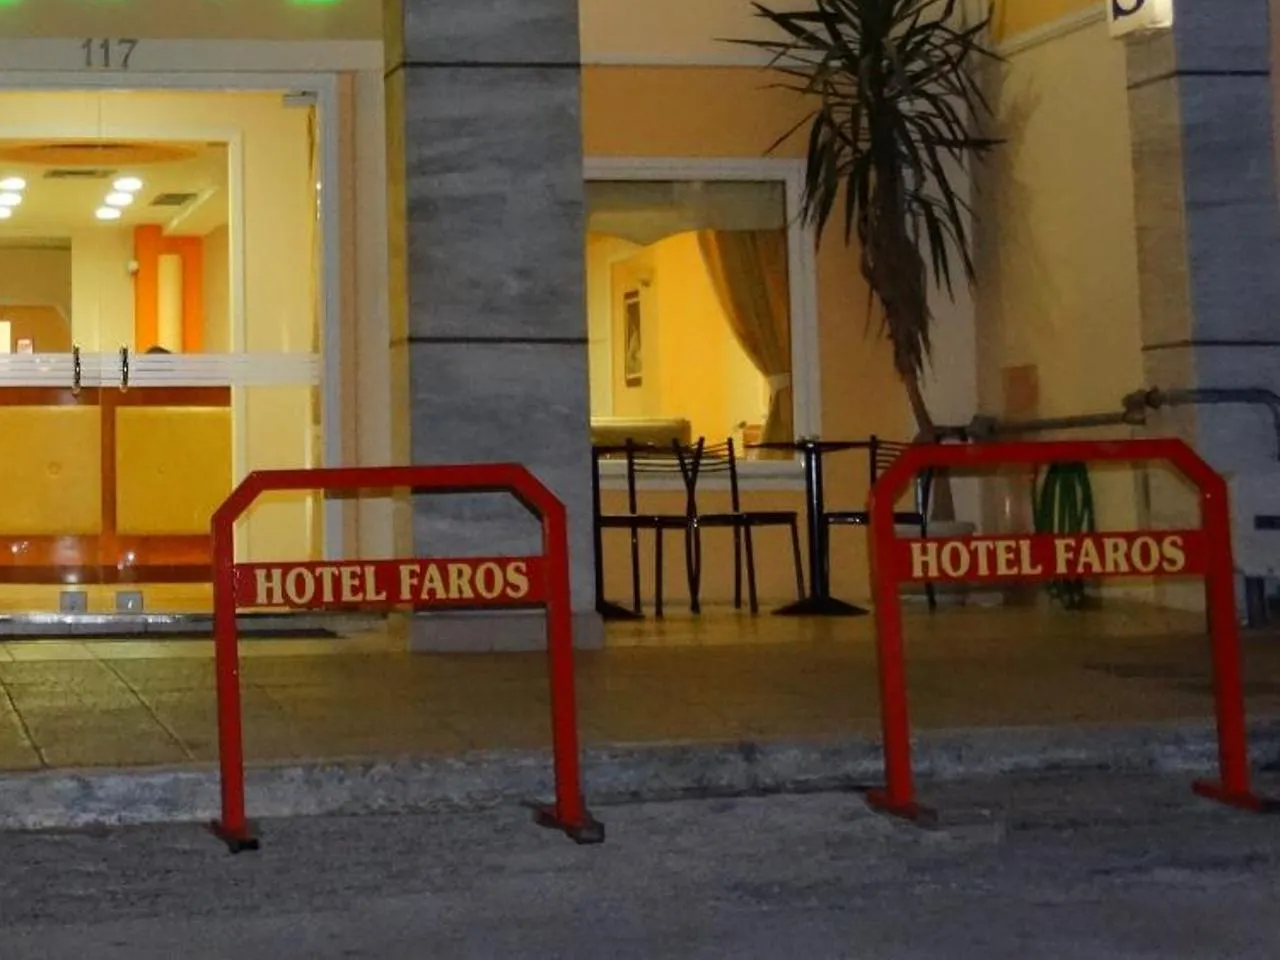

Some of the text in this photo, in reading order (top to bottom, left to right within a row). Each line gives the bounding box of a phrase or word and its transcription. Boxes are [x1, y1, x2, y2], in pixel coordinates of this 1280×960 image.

[81, 38, 138, 67] 117
[910, 534, 1186, 579] HOTEL FAROS
[254, 561, 530, 605] HOTEL FAROS
